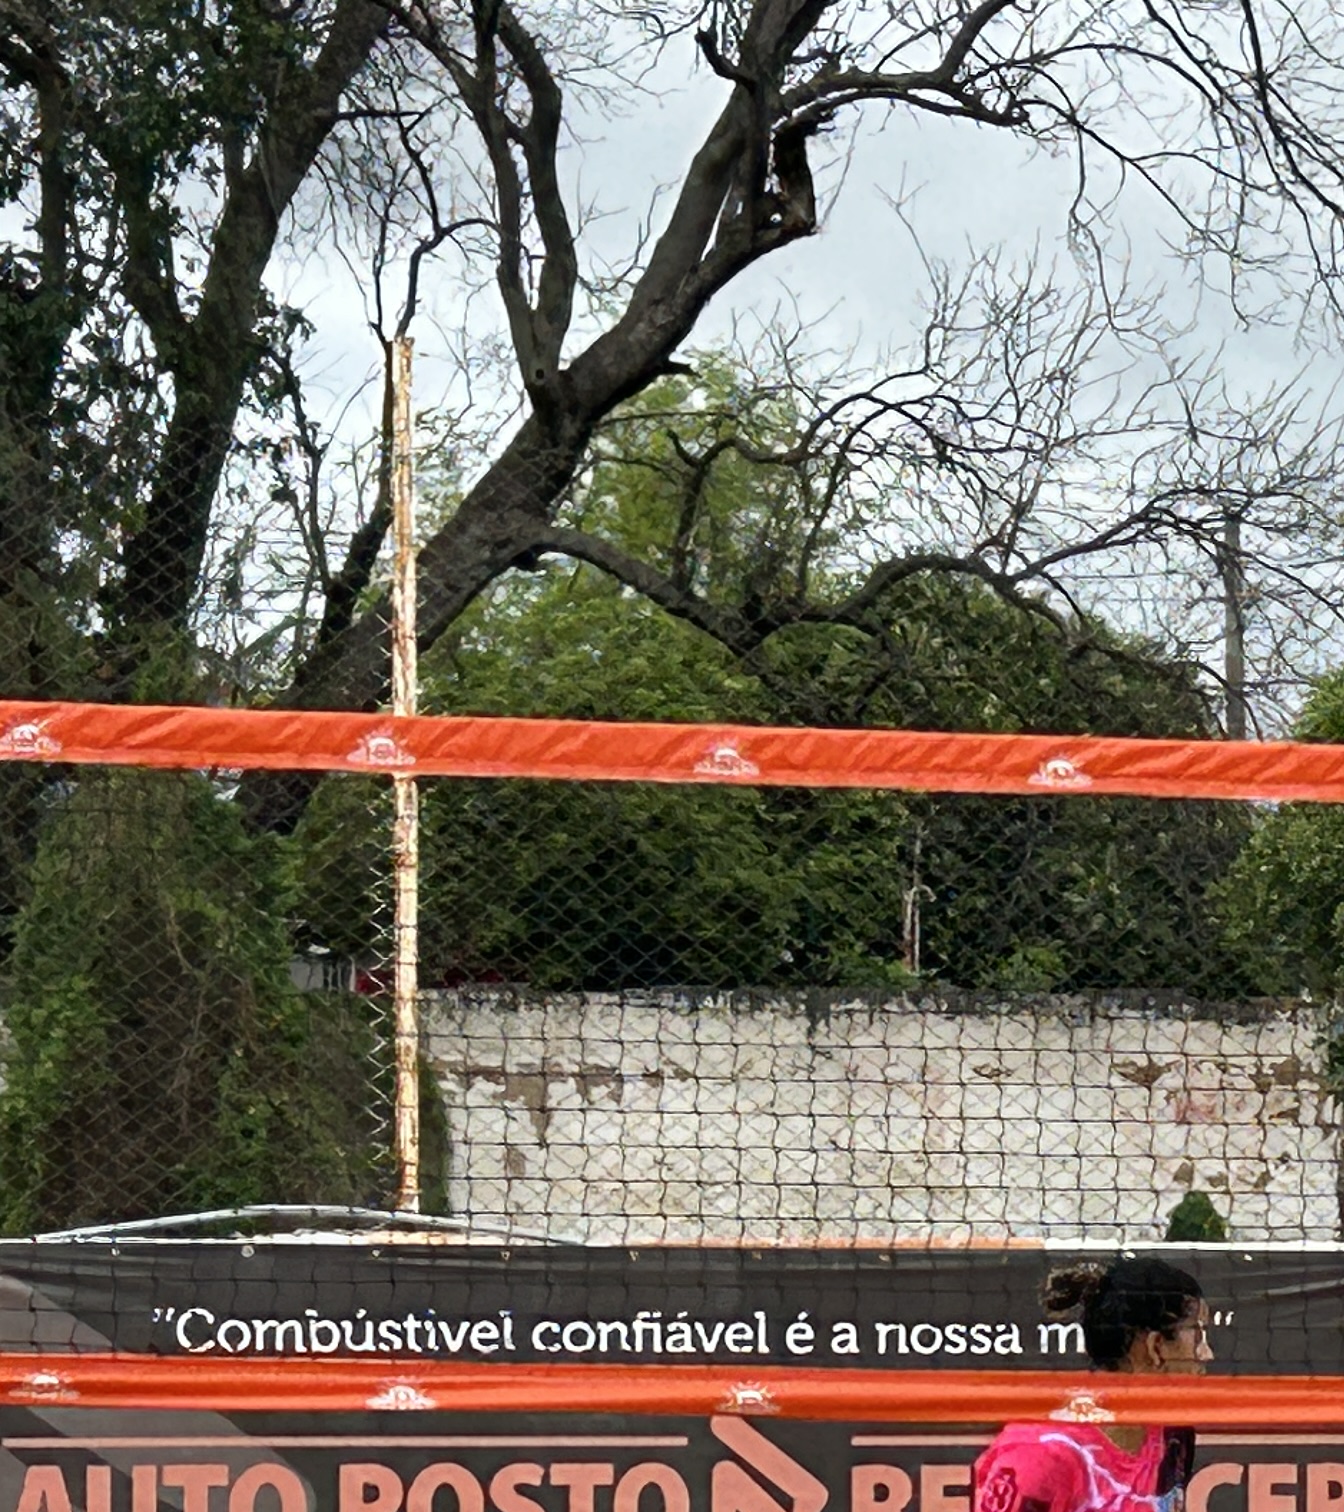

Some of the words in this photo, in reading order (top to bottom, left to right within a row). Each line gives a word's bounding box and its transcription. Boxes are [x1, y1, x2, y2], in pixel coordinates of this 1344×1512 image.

[531, 1310, 771, 1354] confiável
[784, 1311, 815, 1355] é
[830, 1321, 861, 1354] a
[874, 1321, 1024, 1355] nossa
